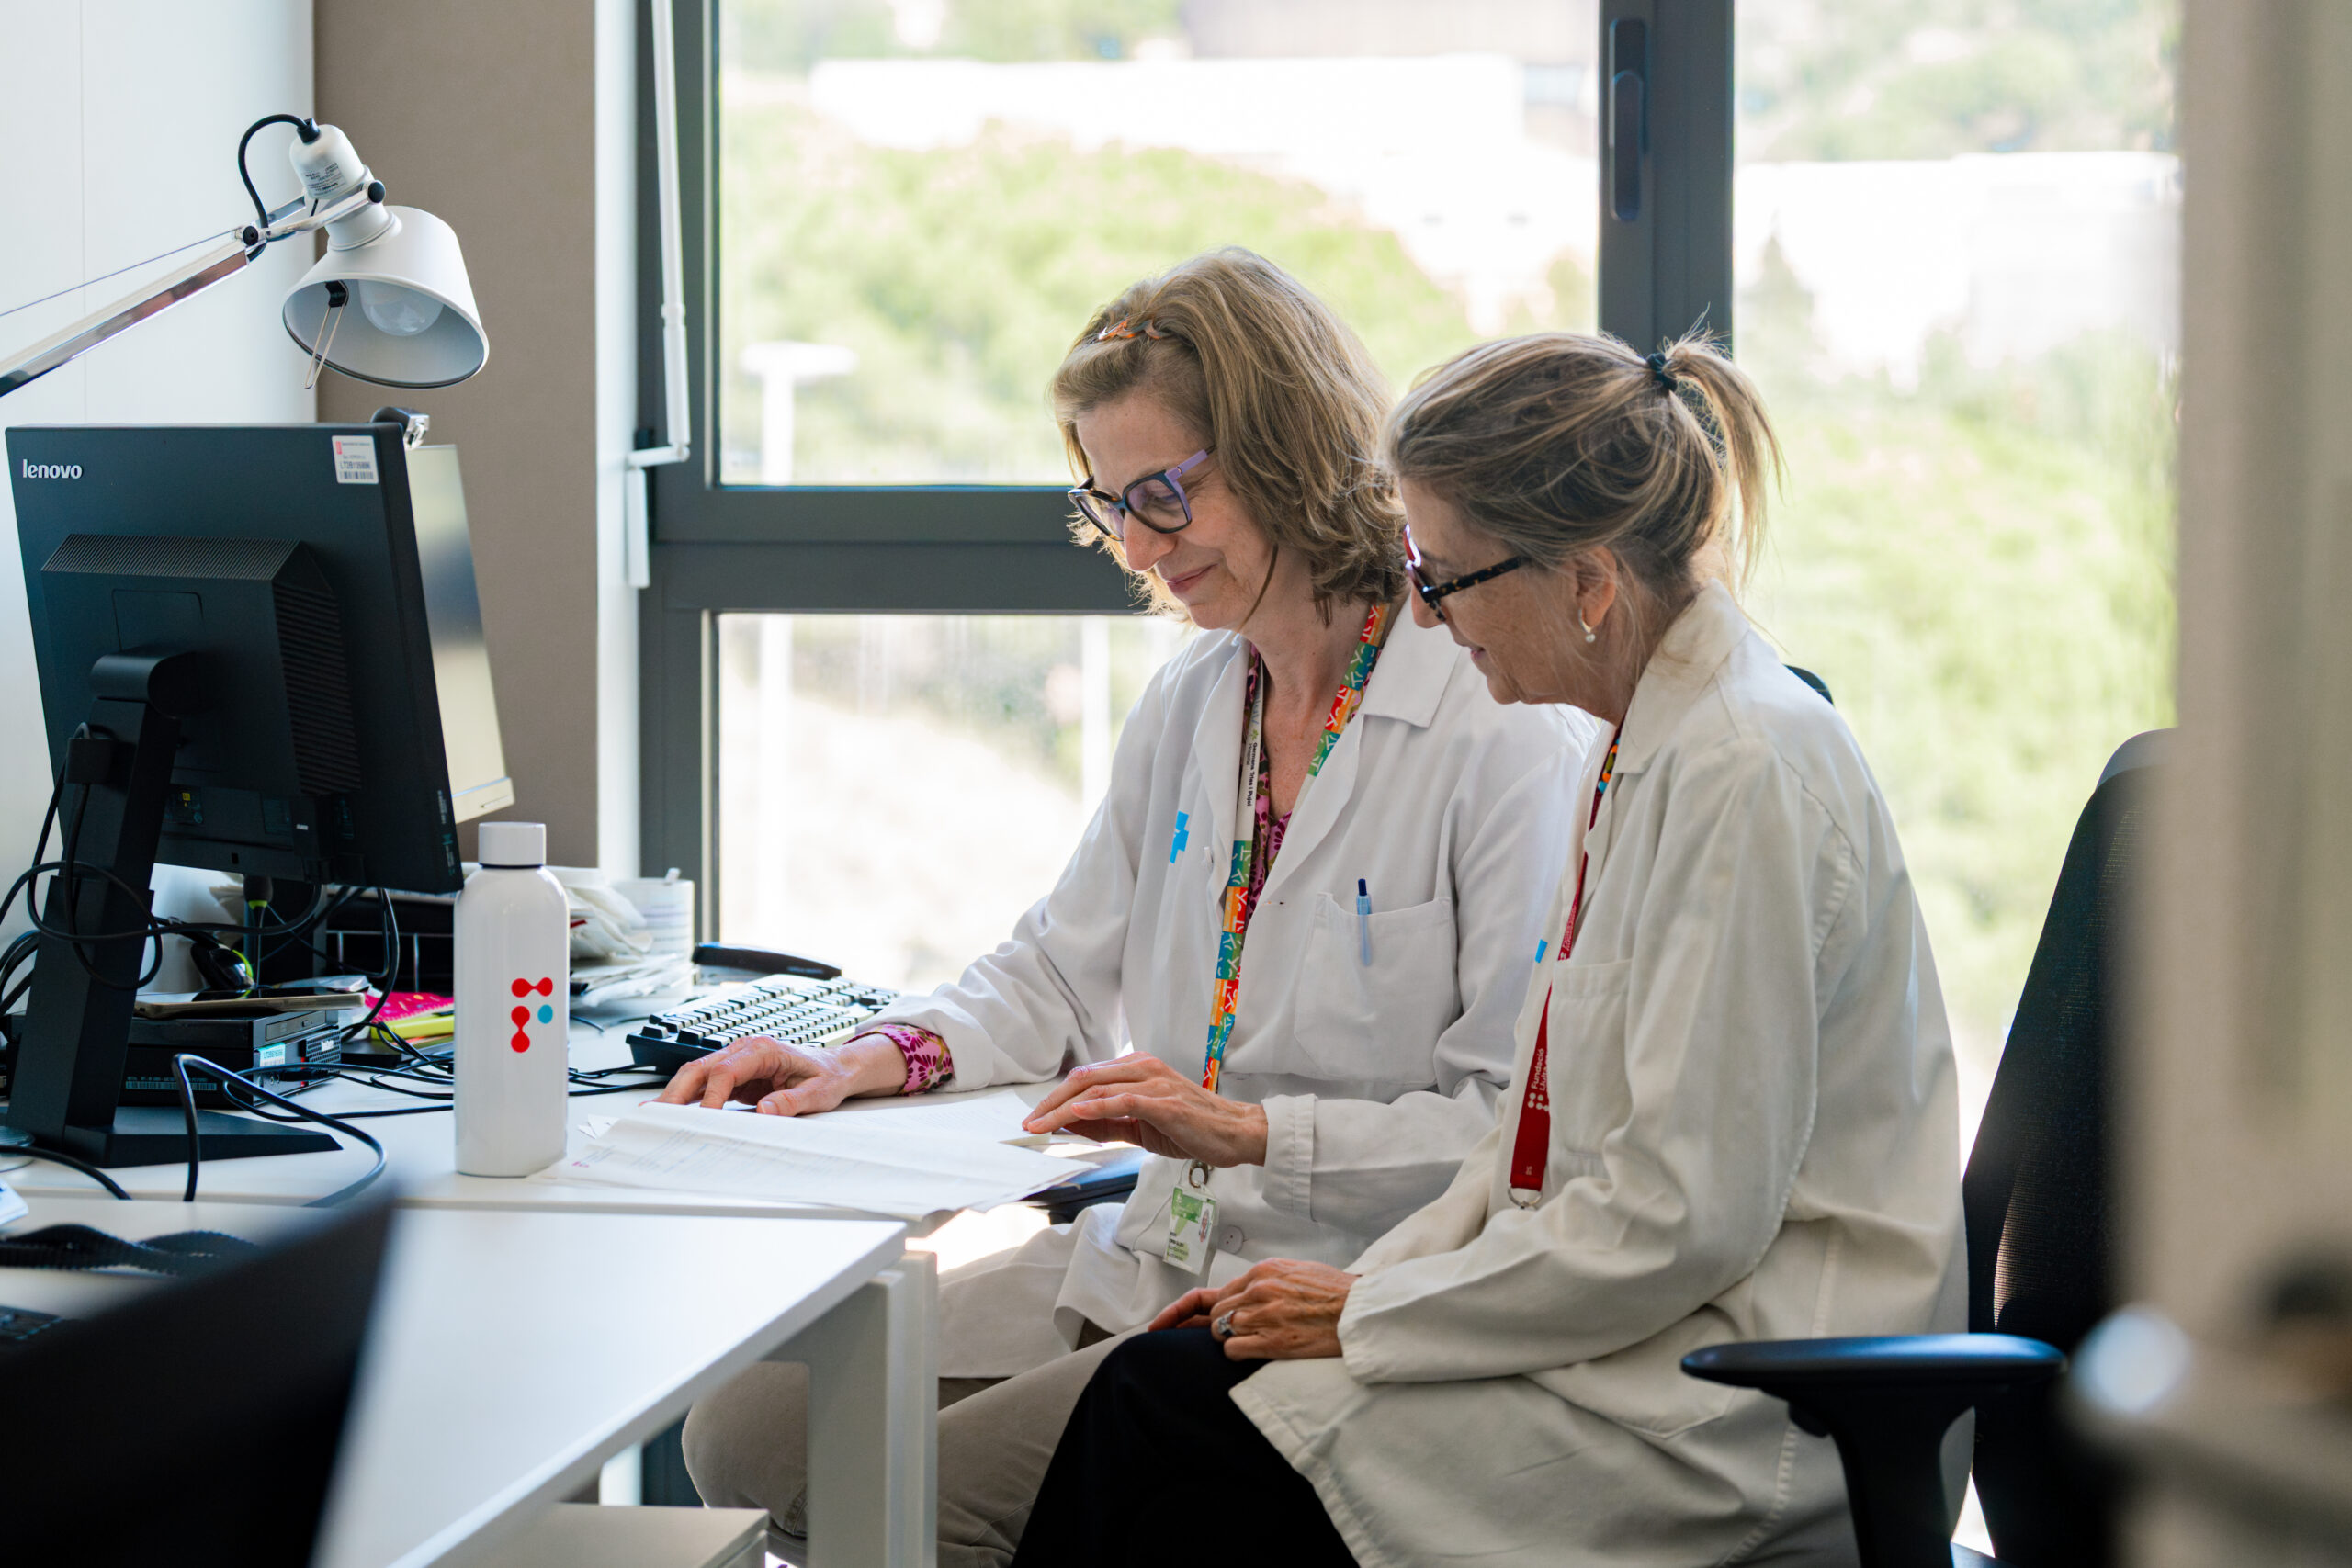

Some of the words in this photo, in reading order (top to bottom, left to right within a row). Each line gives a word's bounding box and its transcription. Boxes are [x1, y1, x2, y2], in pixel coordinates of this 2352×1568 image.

[23, 459, 82, 479] lenovo
[1246, 790, 1254, 807] Pujol
[1531, 1048, 1544, 1089] Fundació
